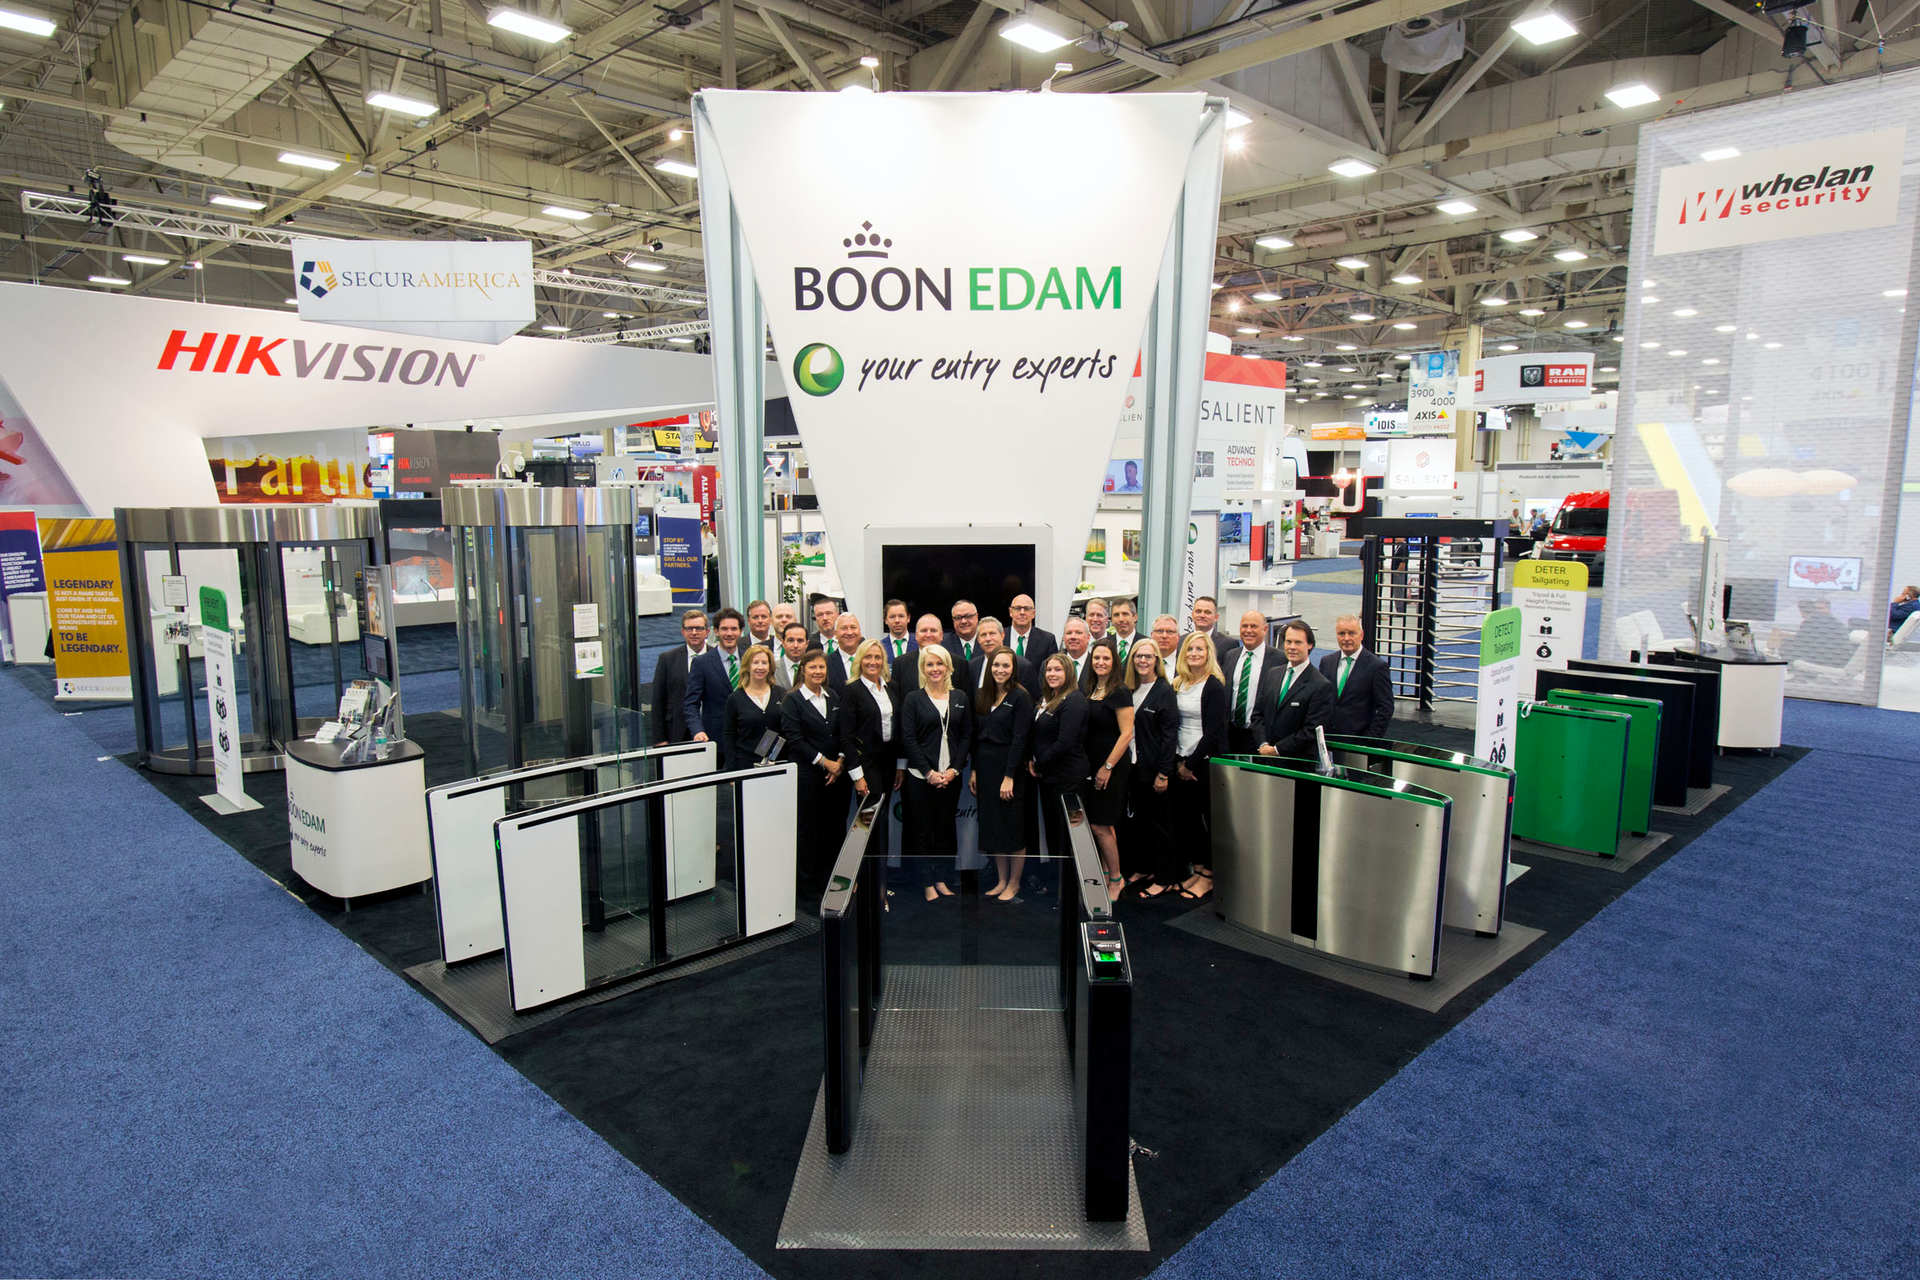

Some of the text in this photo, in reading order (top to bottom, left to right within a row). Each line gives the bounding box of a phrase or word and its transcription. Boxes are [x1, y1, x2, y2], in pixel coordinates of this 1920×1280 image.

[1742, 164, 1874, 200] whelan
[1739, 186, 1872, 215] security
[342, 271, 521, 301] SECURAMERICA
[794, 265, 1122, 311] BOON EDAM
[857, 348, 1117, 393] your entry experts
[1549, 368, 1586, 376] RAM
[1411, 389, 1435, 398] 3900
[1431, 397, 1456, 406] 4000
[1201, 400, 1275, 424] SALIENT
[1415, 411, 1437, 420] AXIS
[1120, 414, 1143, 422] LIEN
[1378, 420, 1395, 430] IDIS
[1227, 445, 1256, 455] ADVANCE
[398, 457, 430, 470] HIKVISION
[1227, 457, 1255, 467] TECHNOL
[1396, 475, 1448, 484] SALIENT
[1535, 566, 1566, 575] DETER
[54, 580, 114, 589] LEGENDARY
[1532, 576, 1570, 587] Tailgating
[1185, 581, 1194, 611] entry
[1532, 591, 1550, 599] Tripod
[1545, 599, 1571, 607] Turnstiles
[1184, 616, 1194, 633] exp
[1494, 621, 1514, 639] DETECT
[59, 632, 88, 641] TO BE
[61, 644, 122, 653] LEGENDARY.
[302, 809, 326, 834] EDAM
